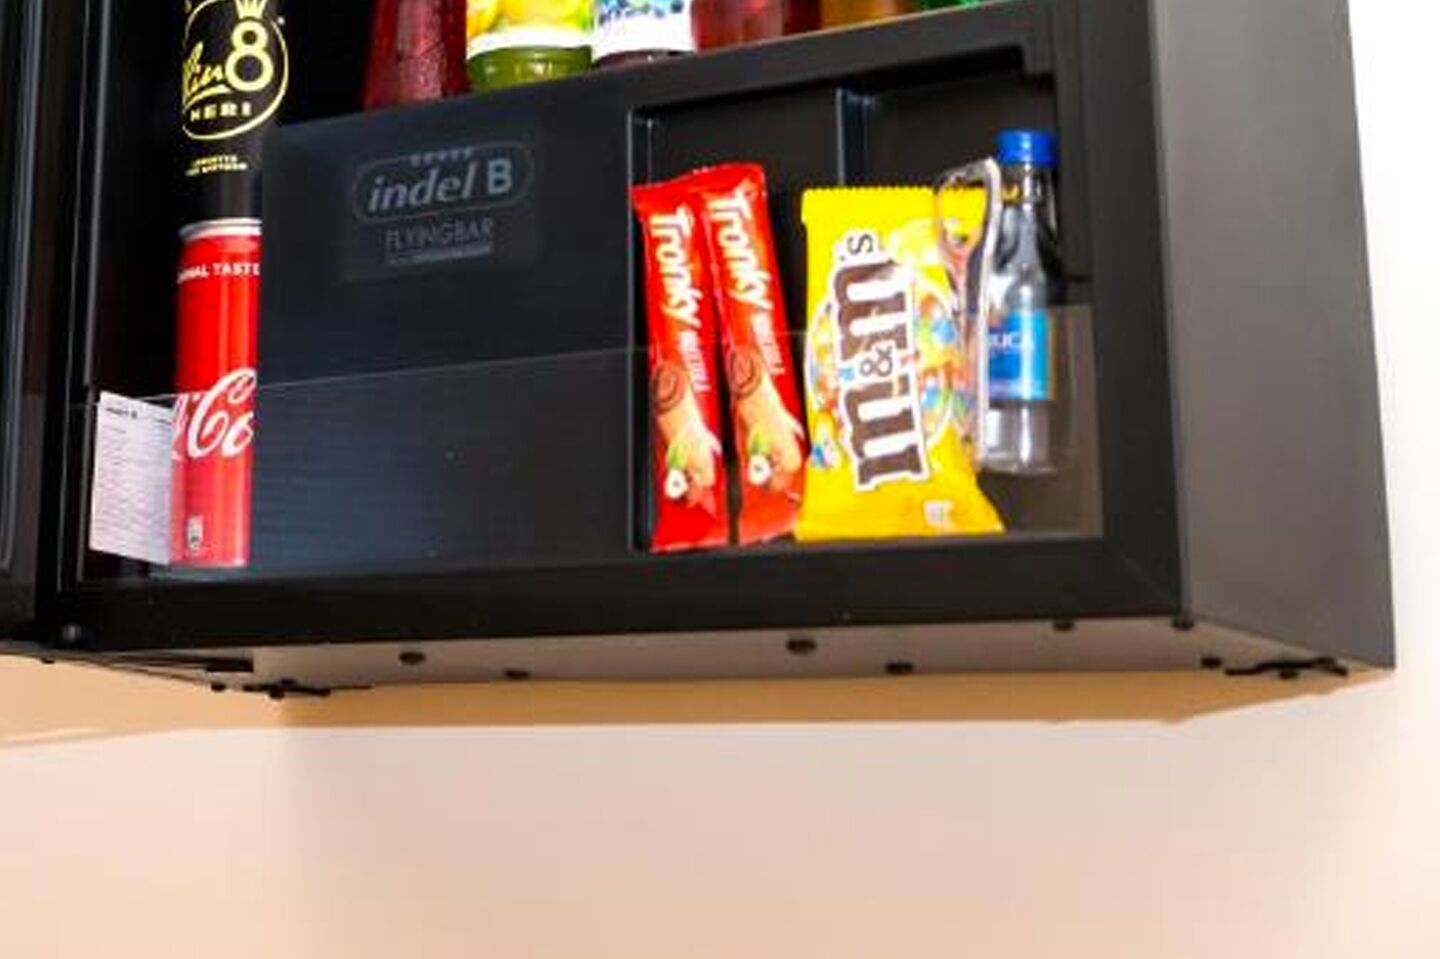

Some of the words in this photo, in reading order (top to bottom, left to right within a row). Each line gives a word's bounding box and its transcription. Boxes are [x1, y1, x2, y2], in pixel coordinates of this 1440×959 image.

[368, 162, 481, 213] indel
[487, 158, 513, 195] B
[706, 184, 774, 306] Tronky
[650, 208, 703, 328] Tronky
